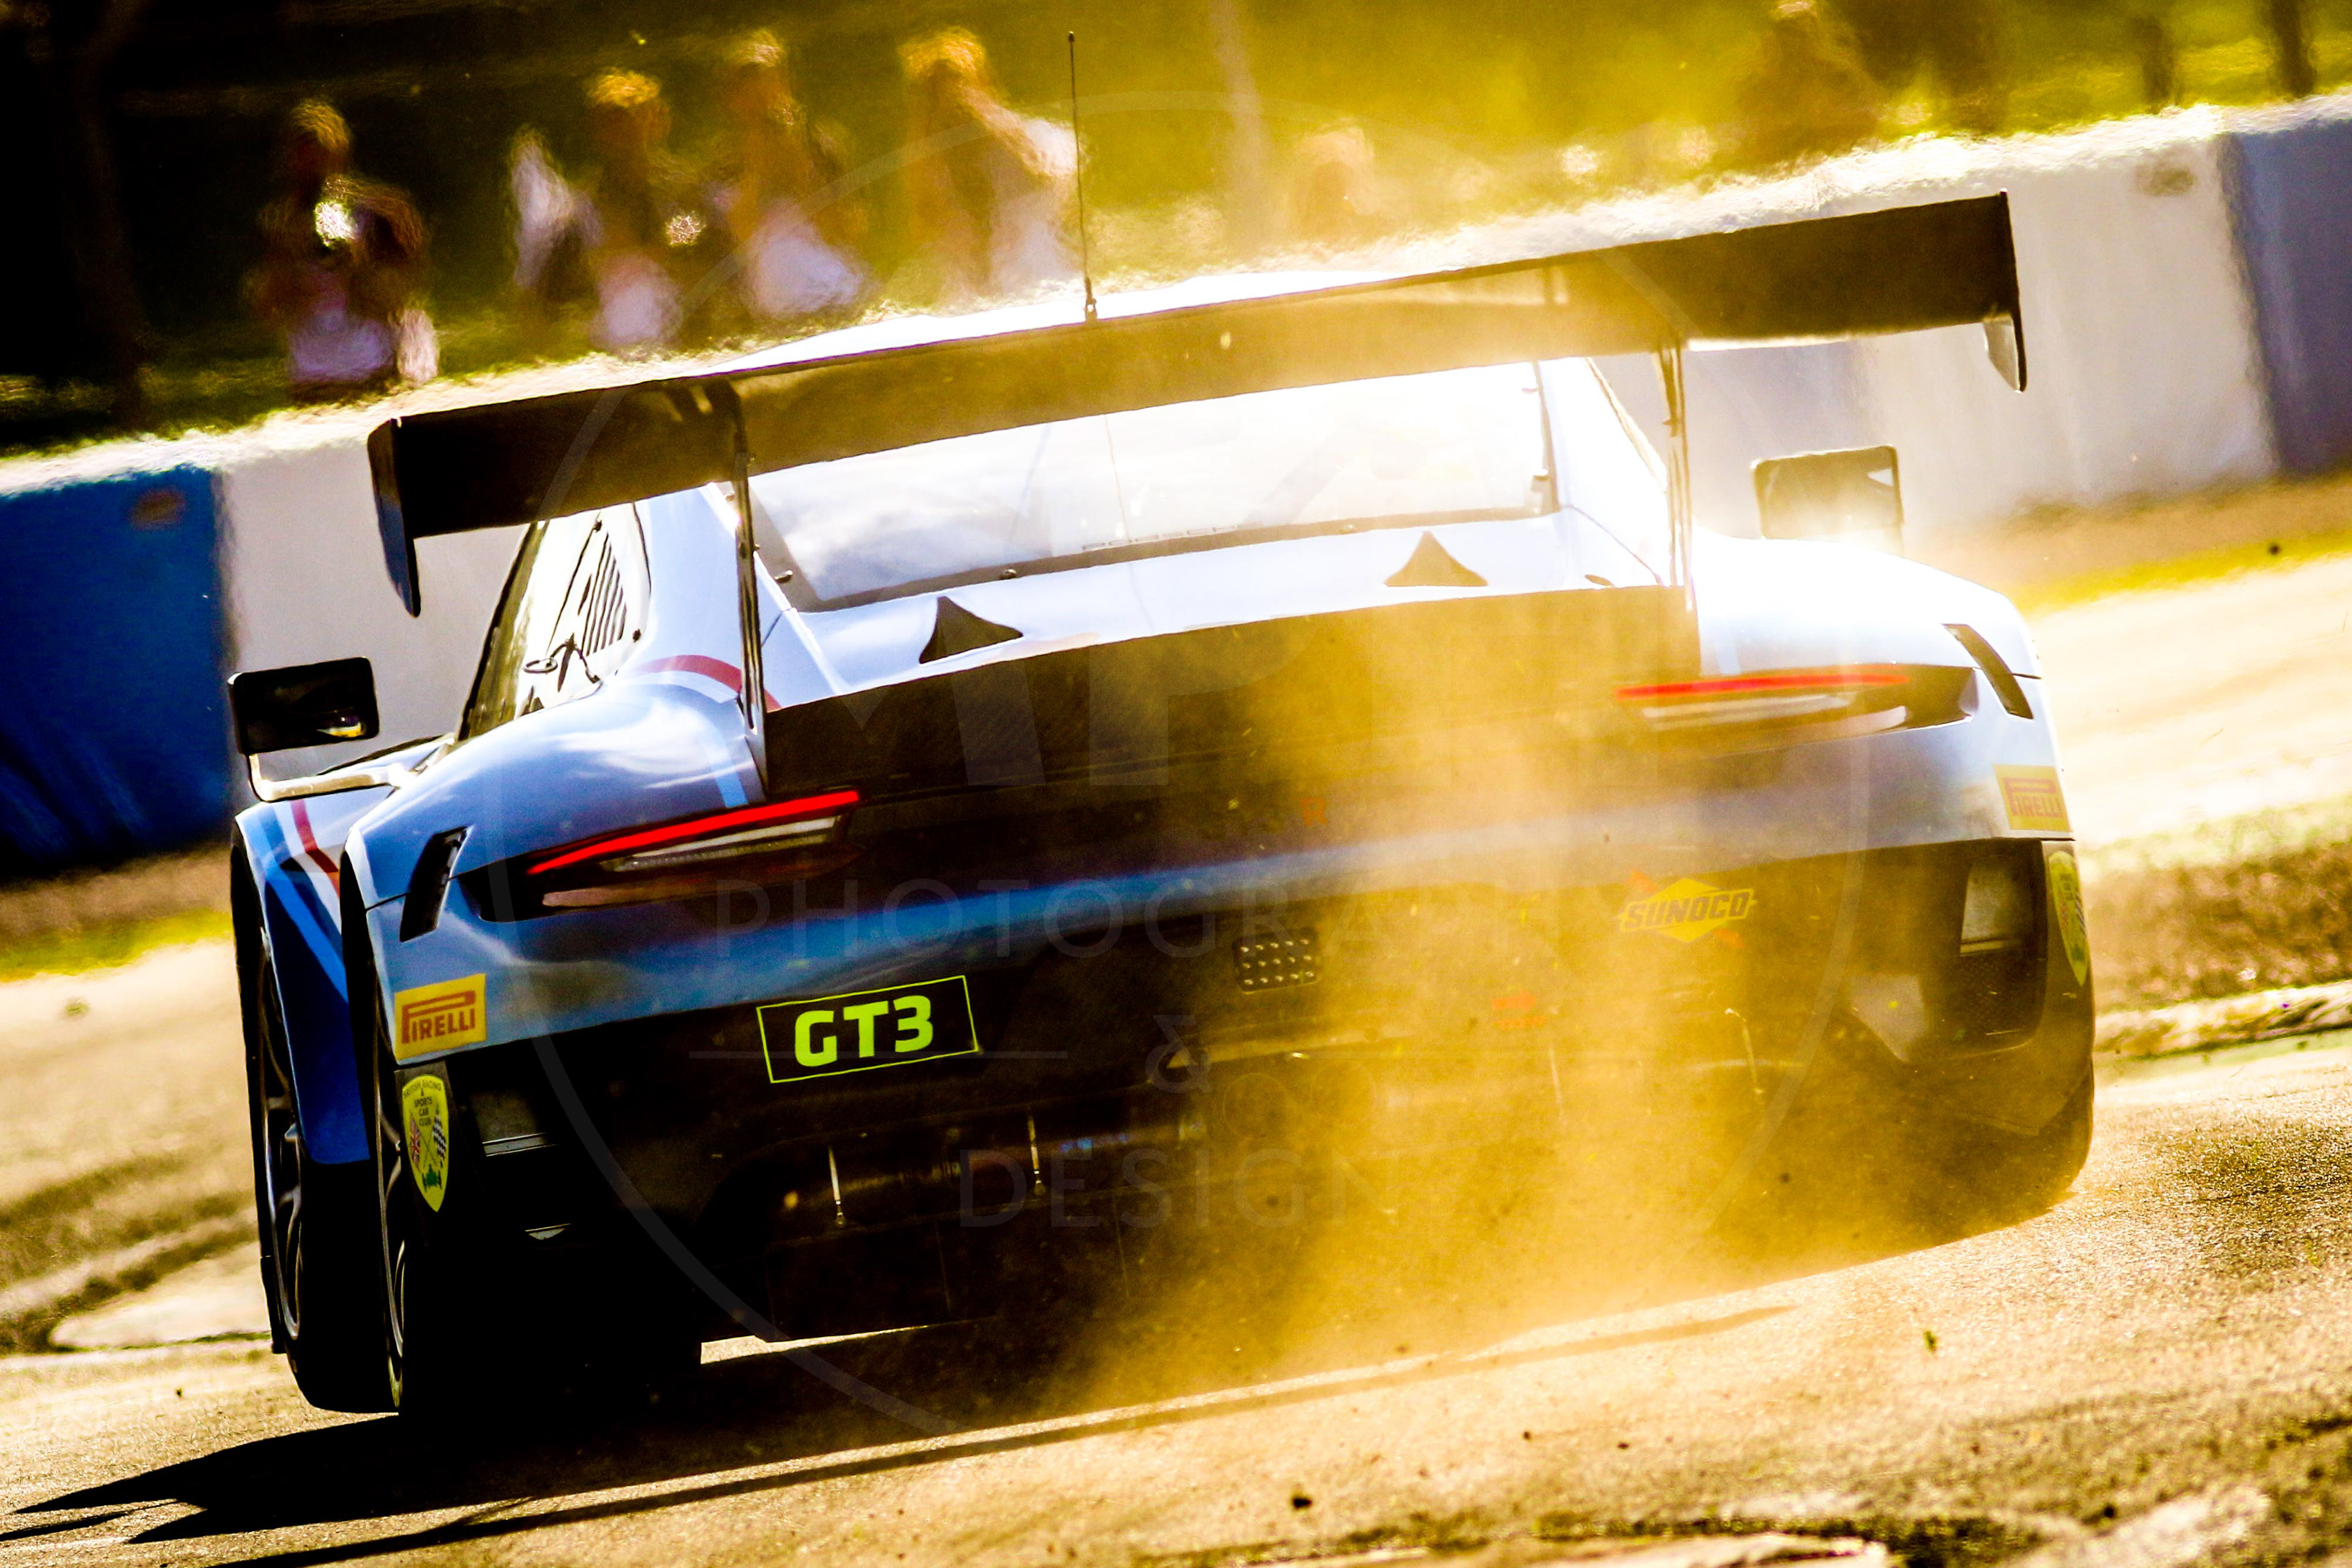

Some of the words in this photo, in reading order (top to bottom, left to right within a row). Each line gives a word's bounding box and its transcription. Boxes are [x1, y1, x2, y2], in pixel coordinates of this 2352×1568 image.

[2002, 777, 2063, 820] PIRELLI
[1623, 891, 1751, 929] SUNOCO
[401, 990, 477, 1044] PIRELLI
[794, 995, 933, 1068] GT3
